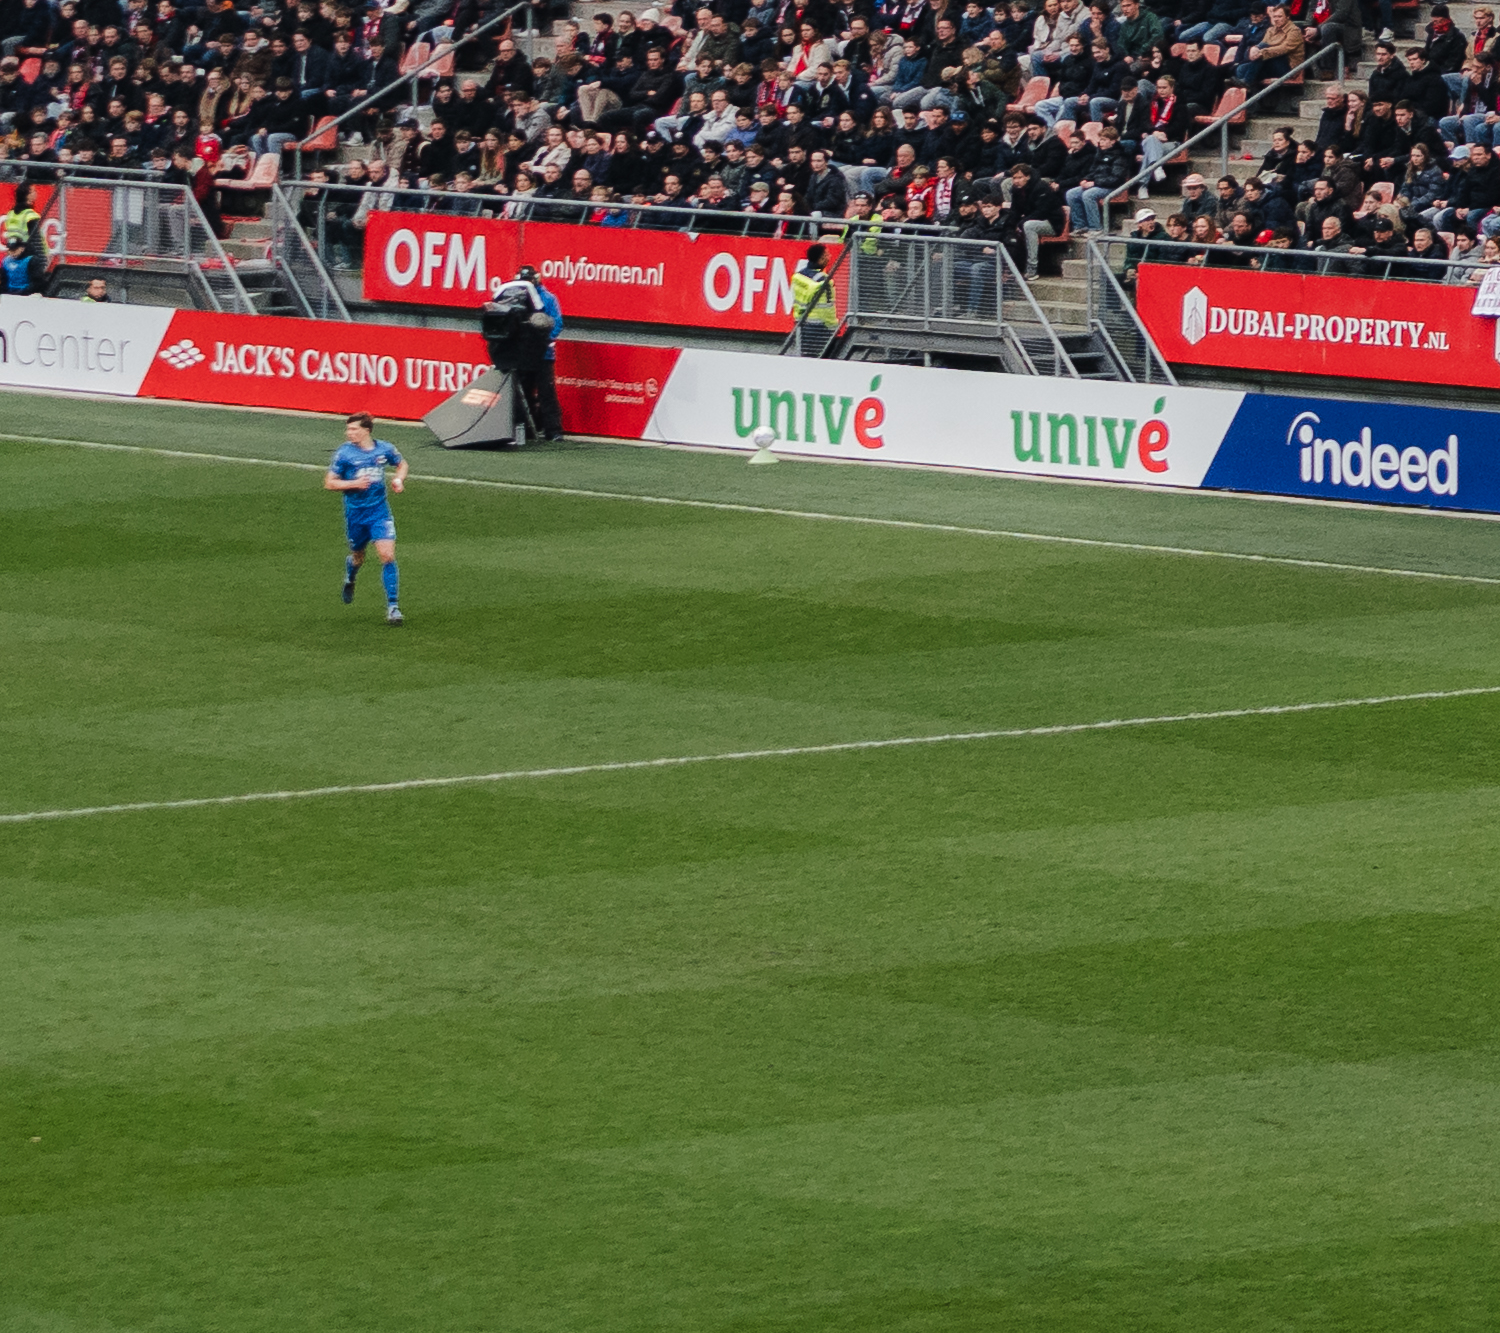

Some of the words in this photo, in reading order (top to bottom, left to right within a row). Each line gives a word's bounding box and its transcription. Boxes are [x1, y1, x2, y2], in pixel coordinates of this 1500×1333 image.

[541, 255, 664, 288] onlyformen.nl
[211, 341, 294, 378] JACK'S
[301, 348, 397, 387] CASINO
[732, 374, 885, 449] univé
[1011, 397, 1169, 473] univé
[1297, 423, 1459, 497] indeed
